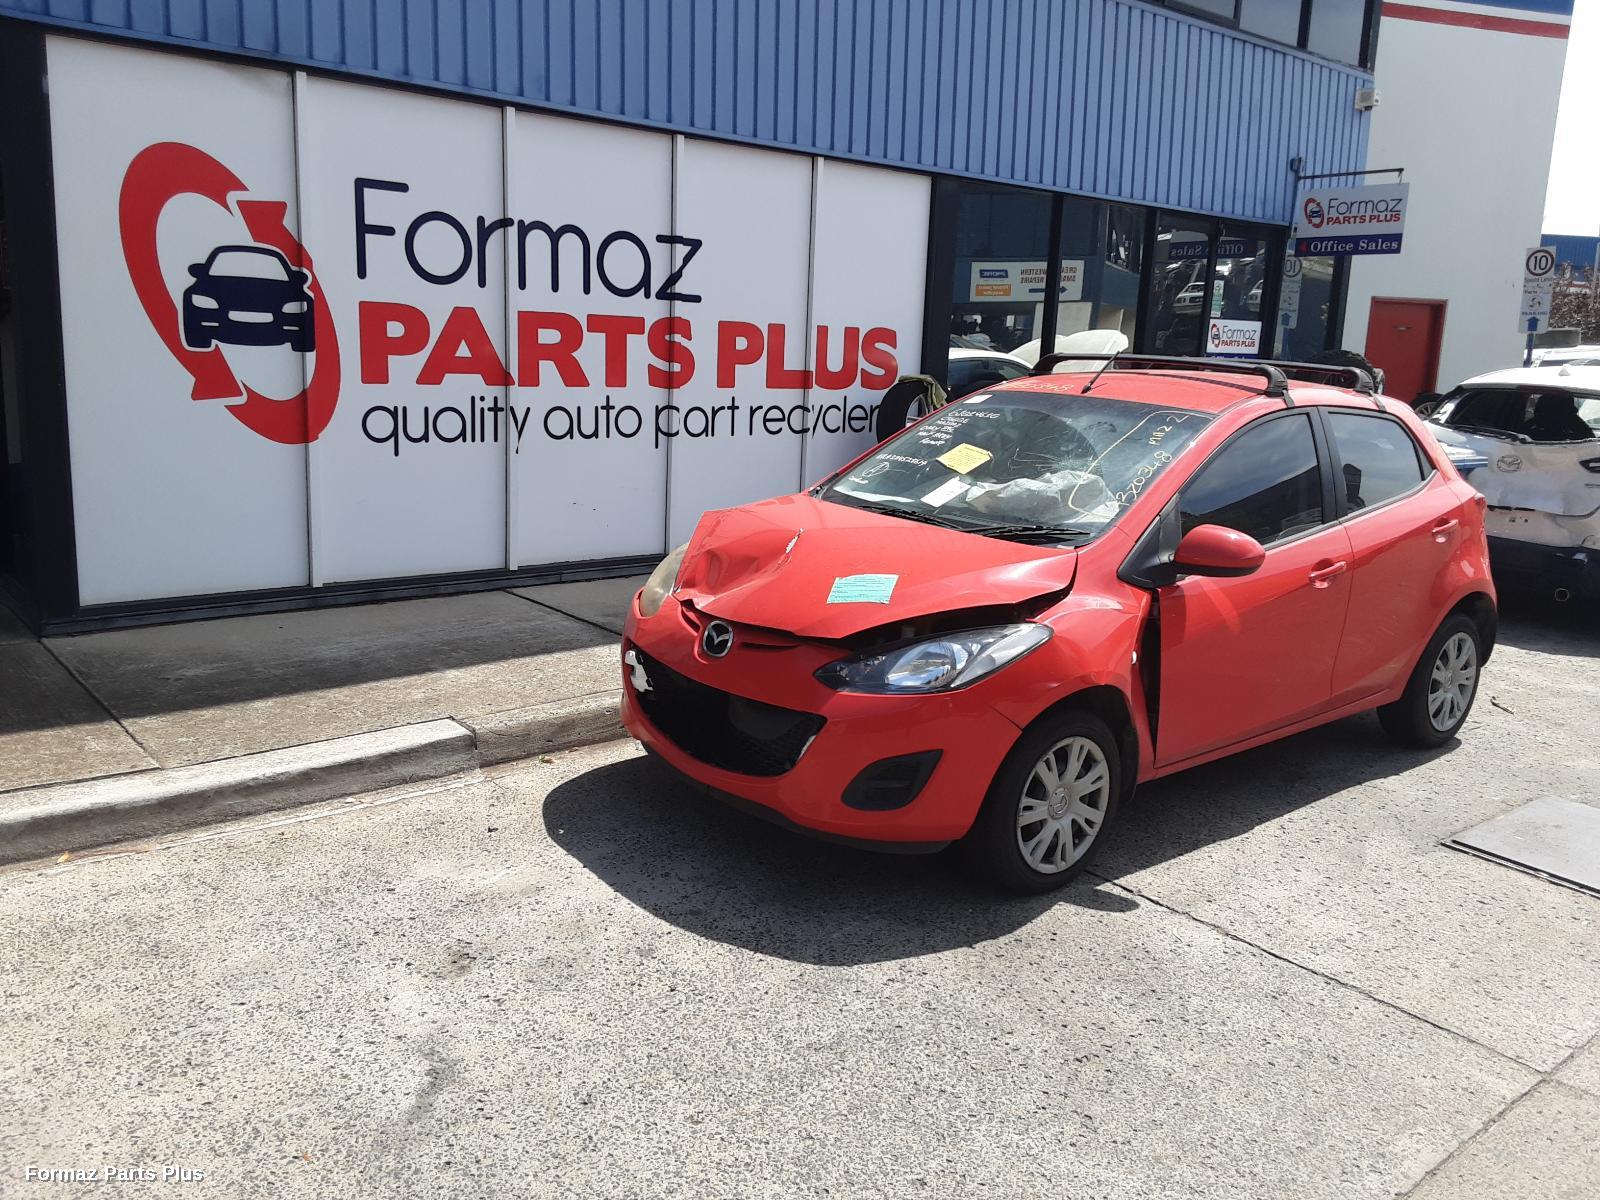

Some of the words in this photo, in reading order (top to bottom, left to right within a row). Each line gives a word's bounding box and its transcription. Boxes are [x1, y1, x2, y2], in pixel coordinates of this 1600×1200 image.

[1327, 198, 1404, 216] Formaz
[1326, 215, 1366, 226] PARTS
[1368, 213, 1401, 223] PLUS
[354, 177, 703, 303] Formaz
[1310, 241, 1354, 252] Office
[1358, 238, 1399, 251] Sales
[1534, 254, 1549, 271] 10
[1222, 325, 1257, 341] Formaz
[359, 301, 696, 389] PARTS
[717, 320, 899, 390] PLUS
[1220, 339, 1240, 347] PARTS
[1241, 340, 1256, 348] PLUS
[362, 396, 531, 457] quality
[543, 395, 643, 440] auto
[654, 396, 740, 449] part
